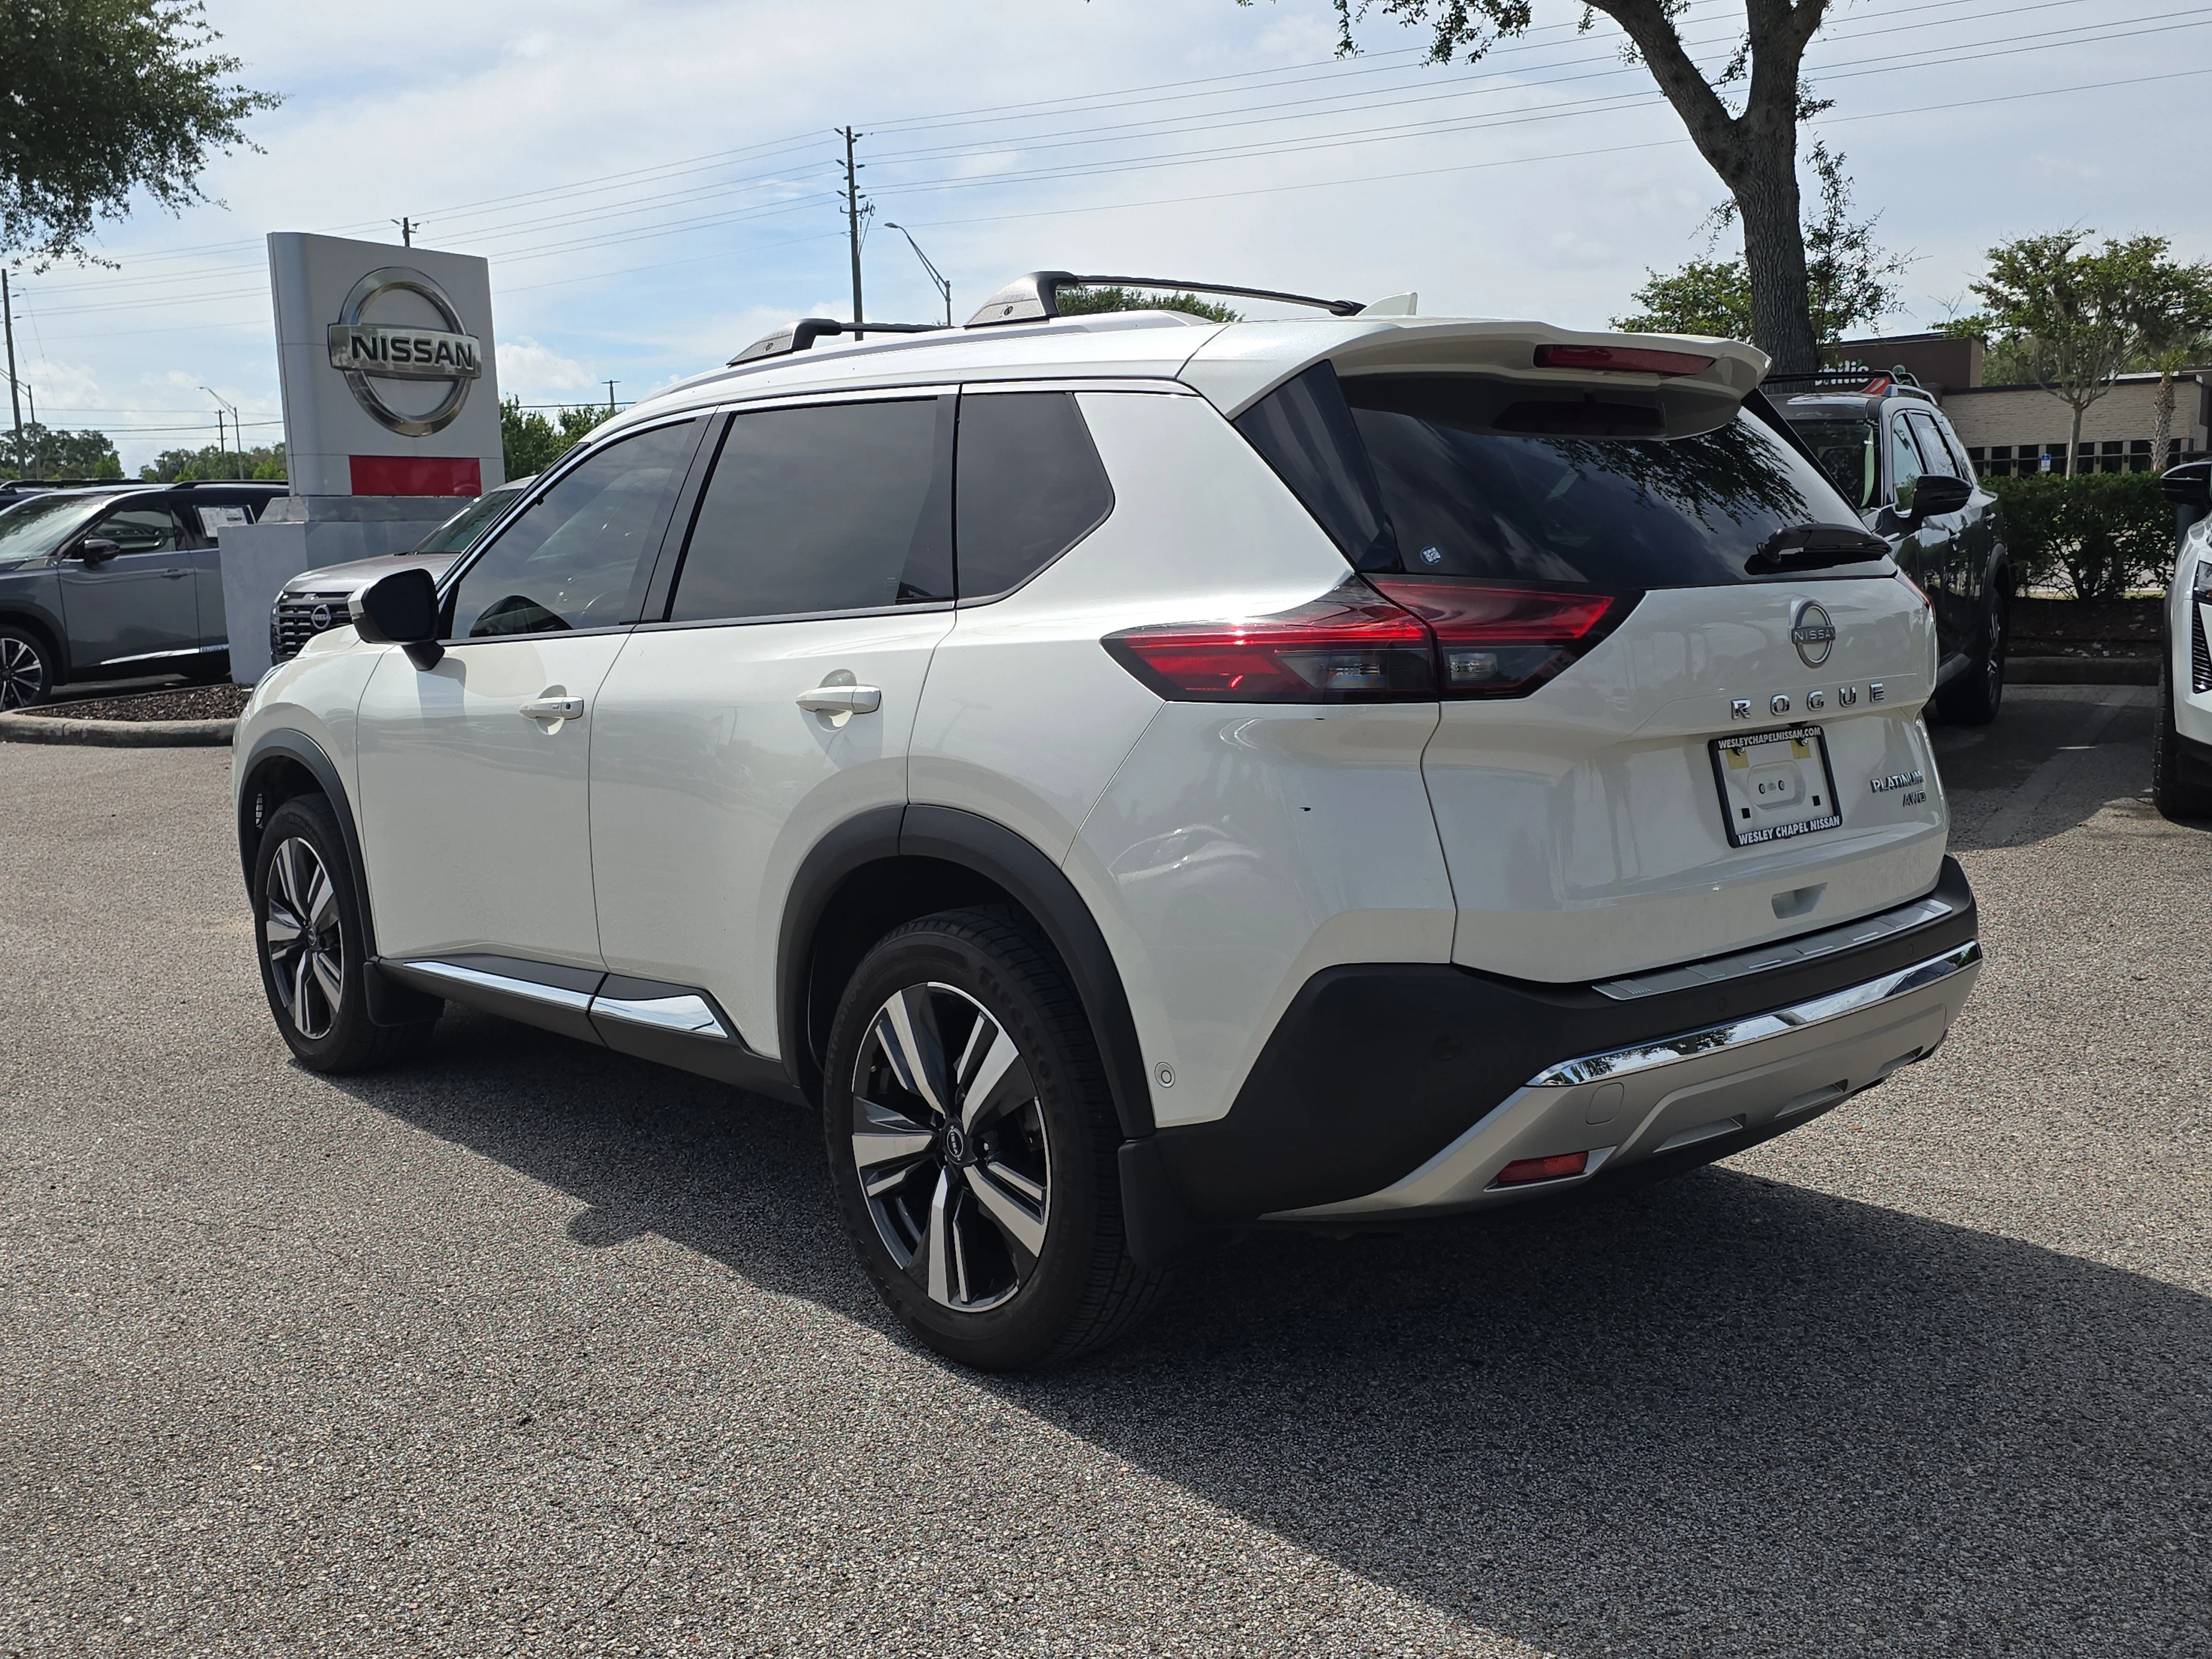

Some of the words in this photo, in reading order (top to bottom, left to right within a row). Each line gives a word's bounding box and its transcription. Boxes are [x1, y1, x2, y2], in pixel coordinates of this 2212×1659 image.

[351, 335, 475, 370] NISSAN
[1731, 682, 1886, 720] ROGUE
[1718, 726, 1821, 749] WESLEYCHAPELNISSAN.COM
[1870, 769, 1924, 793] PLATINUM
[1902, 789, 1927, 808] AWD
[1738, 828, 1774, 845] WESLEY
[1776, 821, 1809, 838] CHAPEL
[1810, 815, 1840, 832] NISSAN
